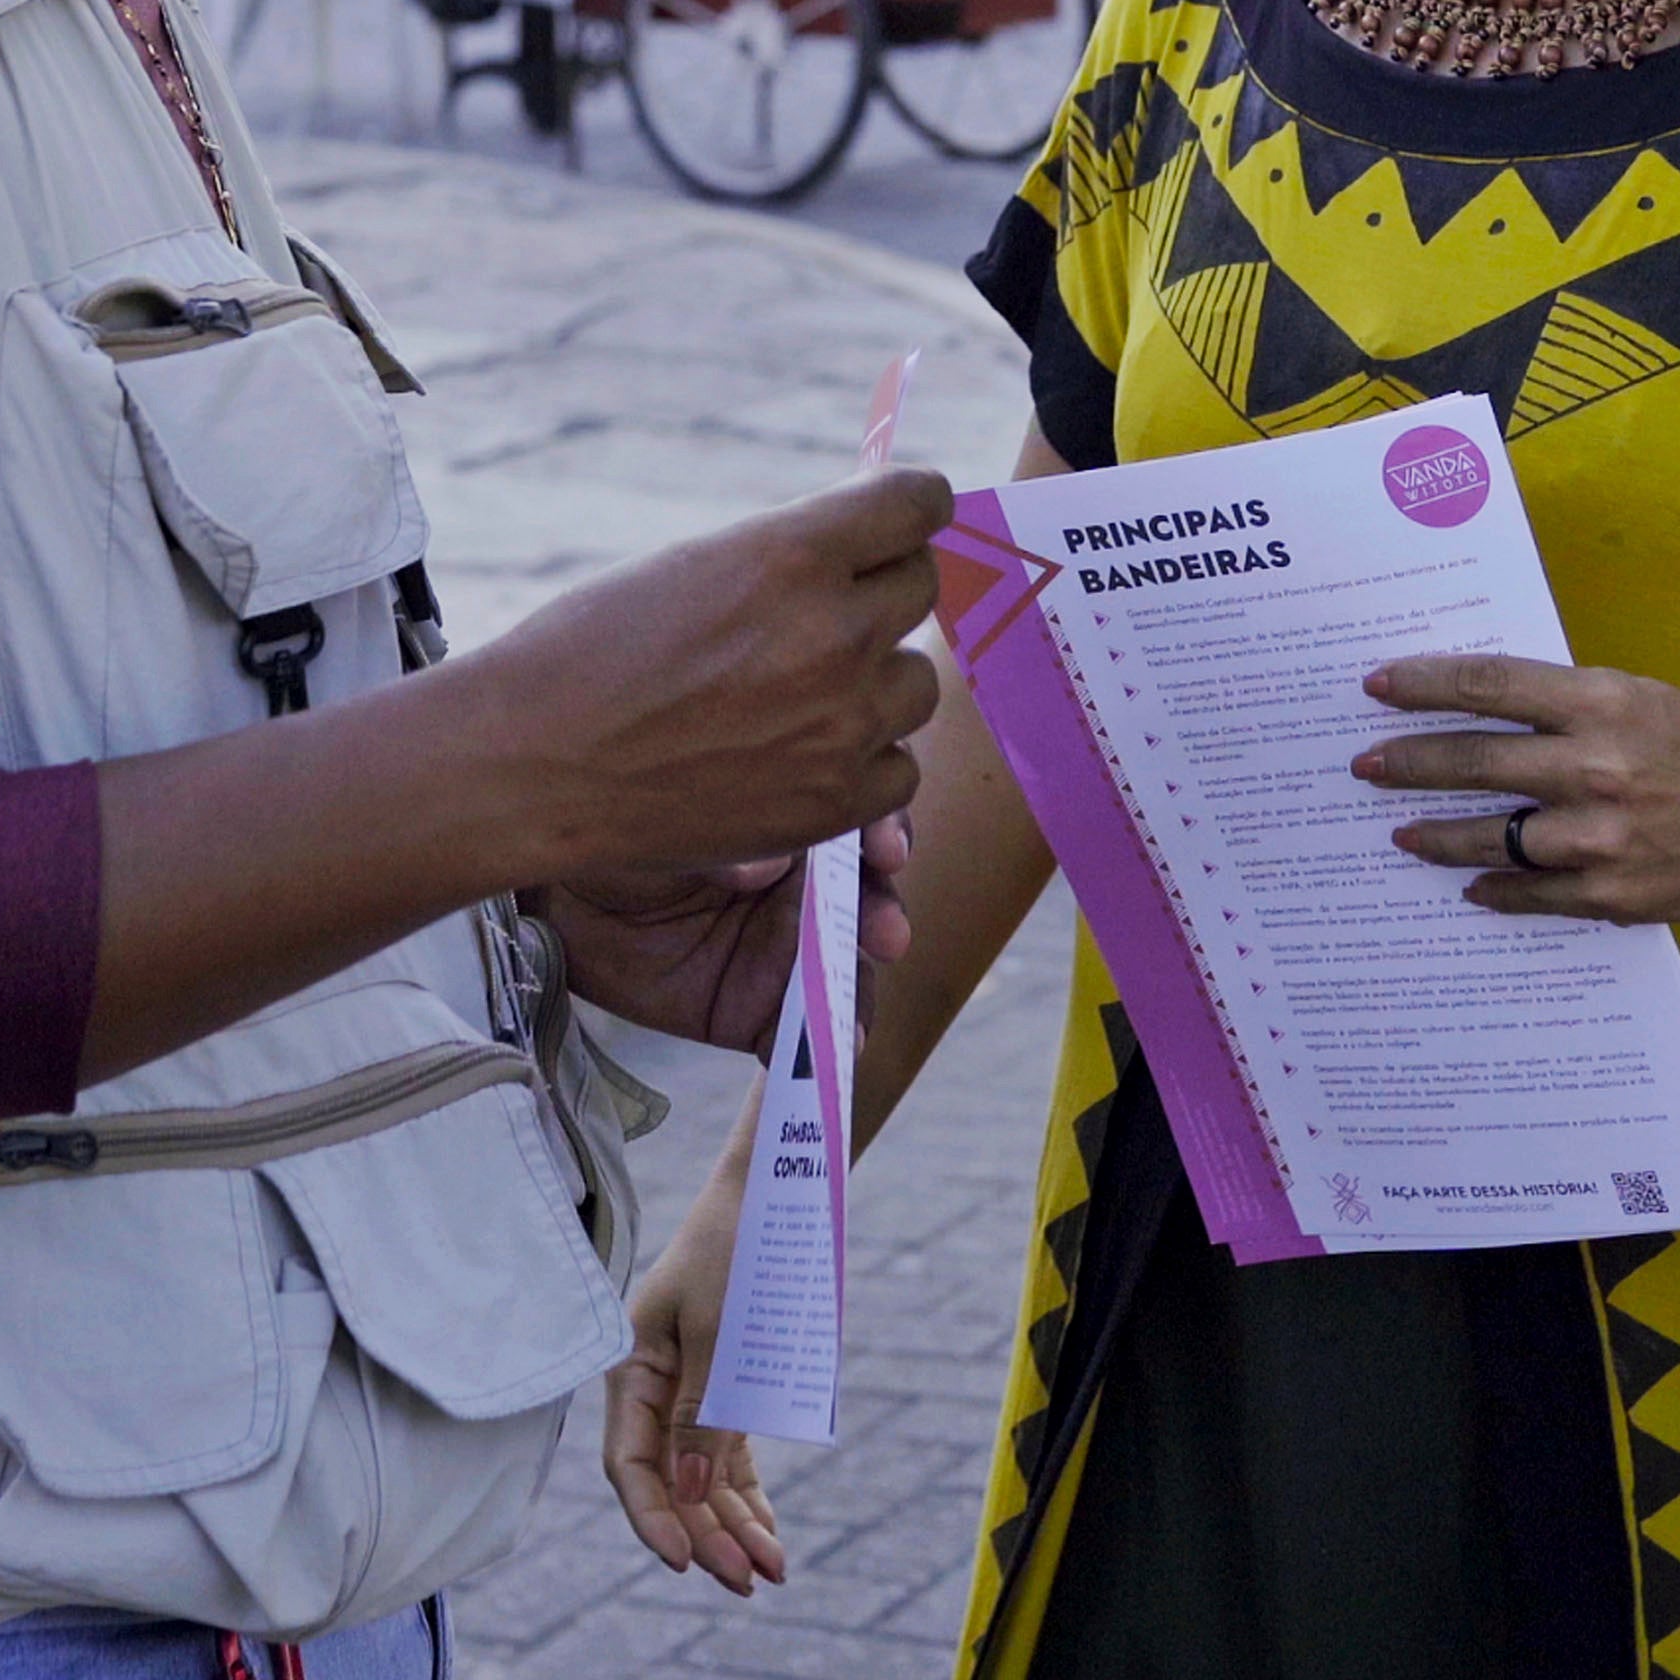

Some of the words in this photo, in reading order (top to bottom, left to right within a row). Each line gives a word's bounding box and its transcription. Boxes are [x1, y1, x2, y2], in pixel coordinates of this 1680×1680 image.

[1389, 451, 1477, 489] VANDA
[1405, 471, 1480, 502] WITOTO
[1063, 498, 1270, 554] PRINCIPAIS
[1079, 540, 1292, 595] BANDEIRAS
[773, 1156, 815, 1178] CONTRA
[1383, 1185, 1421, 1202] FAÇA
[1424, 1185, 1467, 1199] PARTE
[1471, 1184, 1519, 1198] DESSA
[1523, 1179, 1599, 1197] HISTÓRIA!
